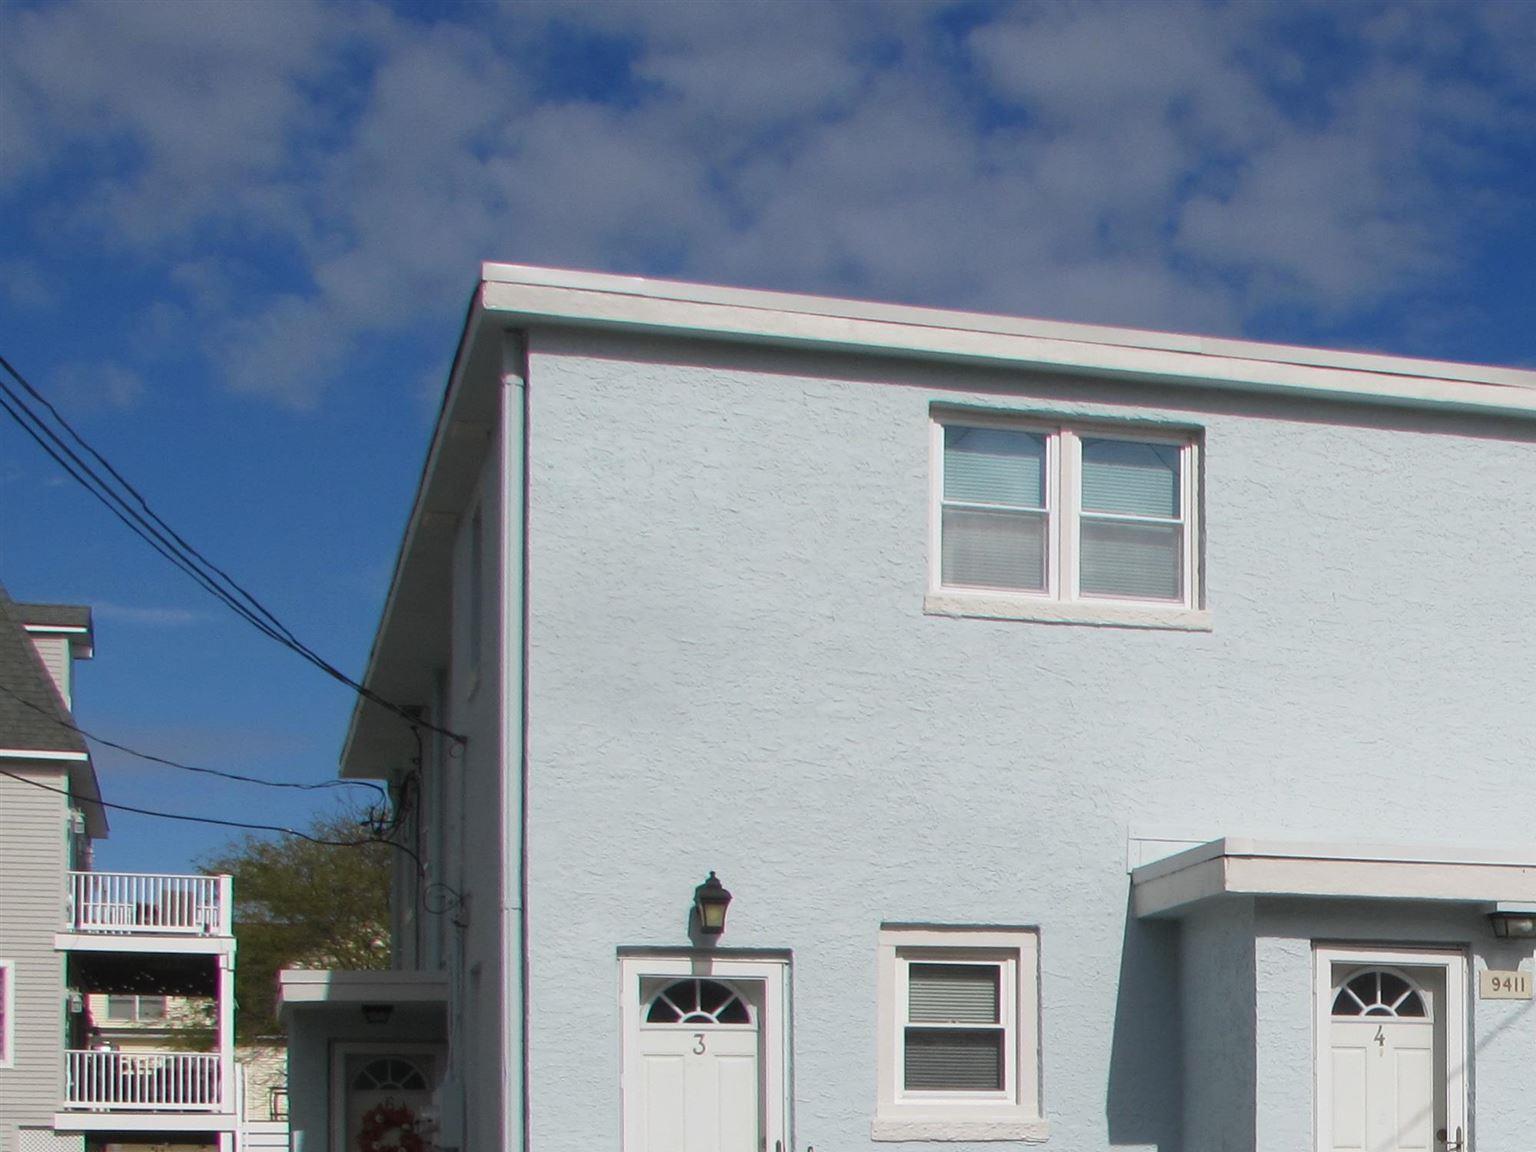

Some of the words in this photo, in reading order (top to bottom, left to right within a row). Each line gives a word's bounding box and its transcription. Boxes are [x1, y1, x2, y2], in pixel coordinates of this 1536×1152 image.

[1491, 977, 1525, 992] 9411
[692, 1033, 706, 1056] 3
[1374, 1024, 1386, 1047] 4
